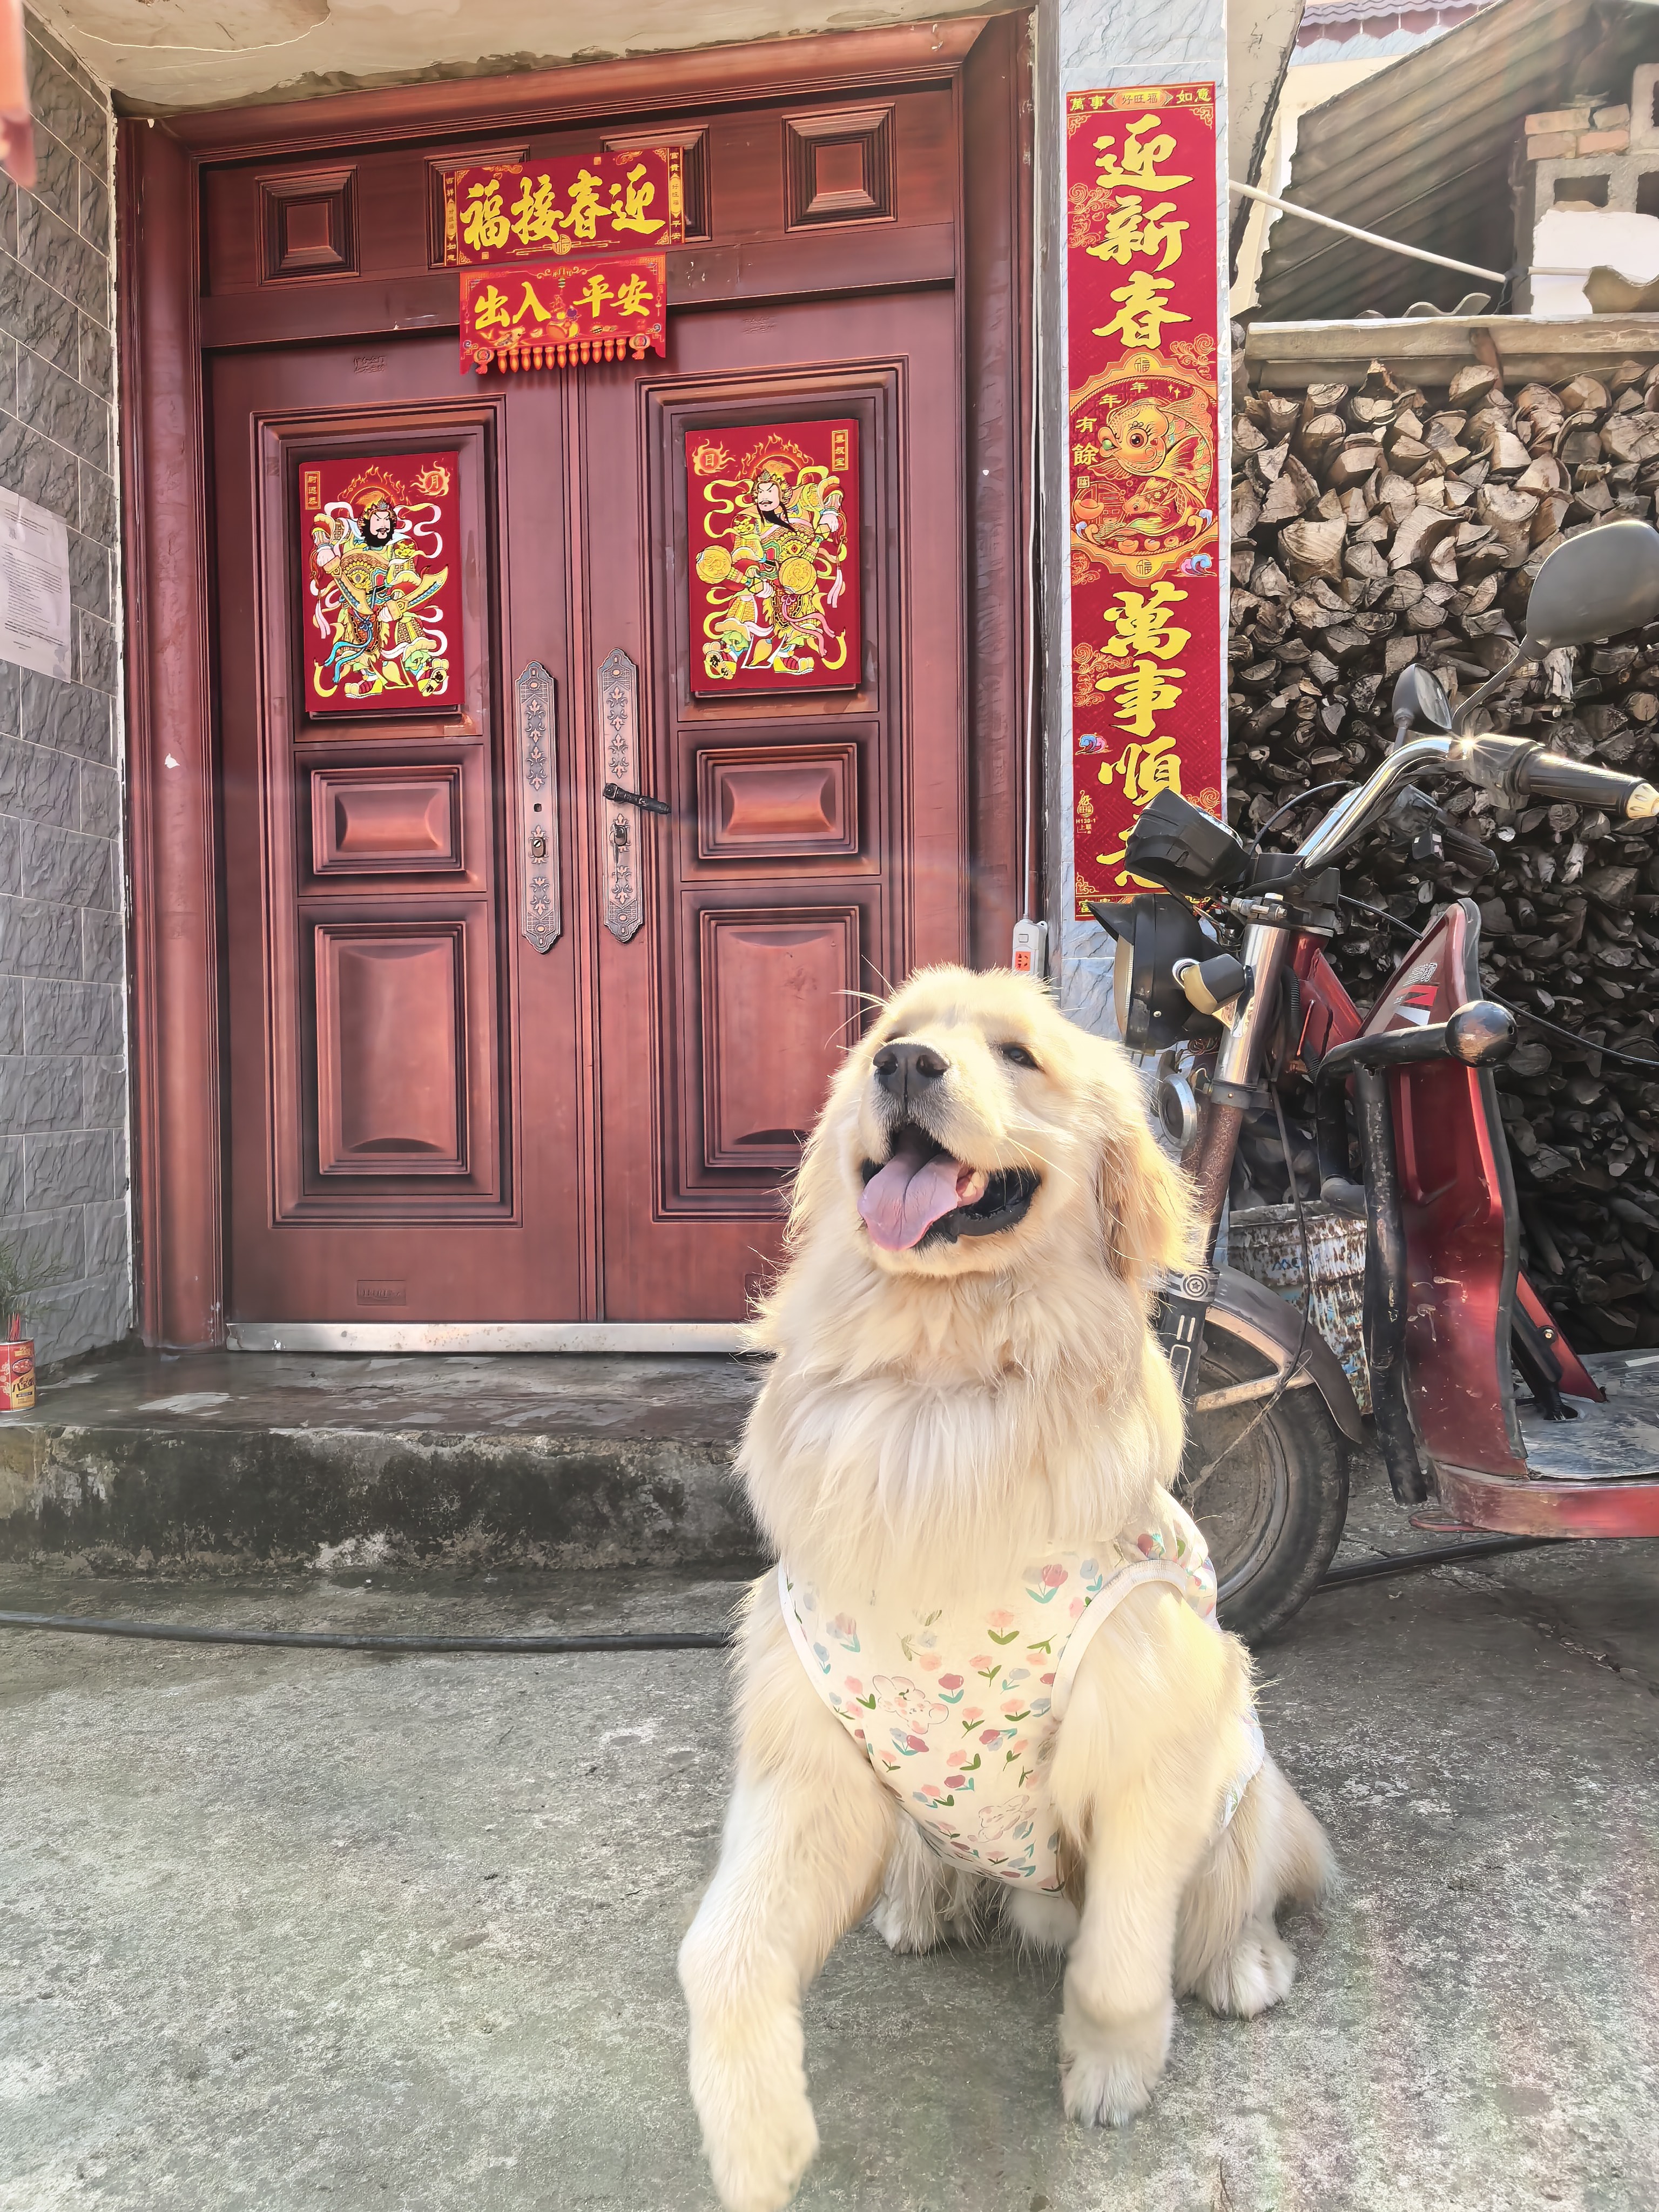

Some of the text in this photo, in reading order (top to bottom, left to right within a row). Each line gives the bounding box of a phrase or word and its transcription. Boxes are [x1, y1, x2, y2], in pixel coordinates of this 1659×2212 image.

[1122, 92, 1158, 104] 好旺福
[1176, 88, 1211, 104] 如意
[1085, 113, 1194, 349] 迎新春
[475, 273, 653, 330] 出入平安
[428, 475, 440, 491] 月
